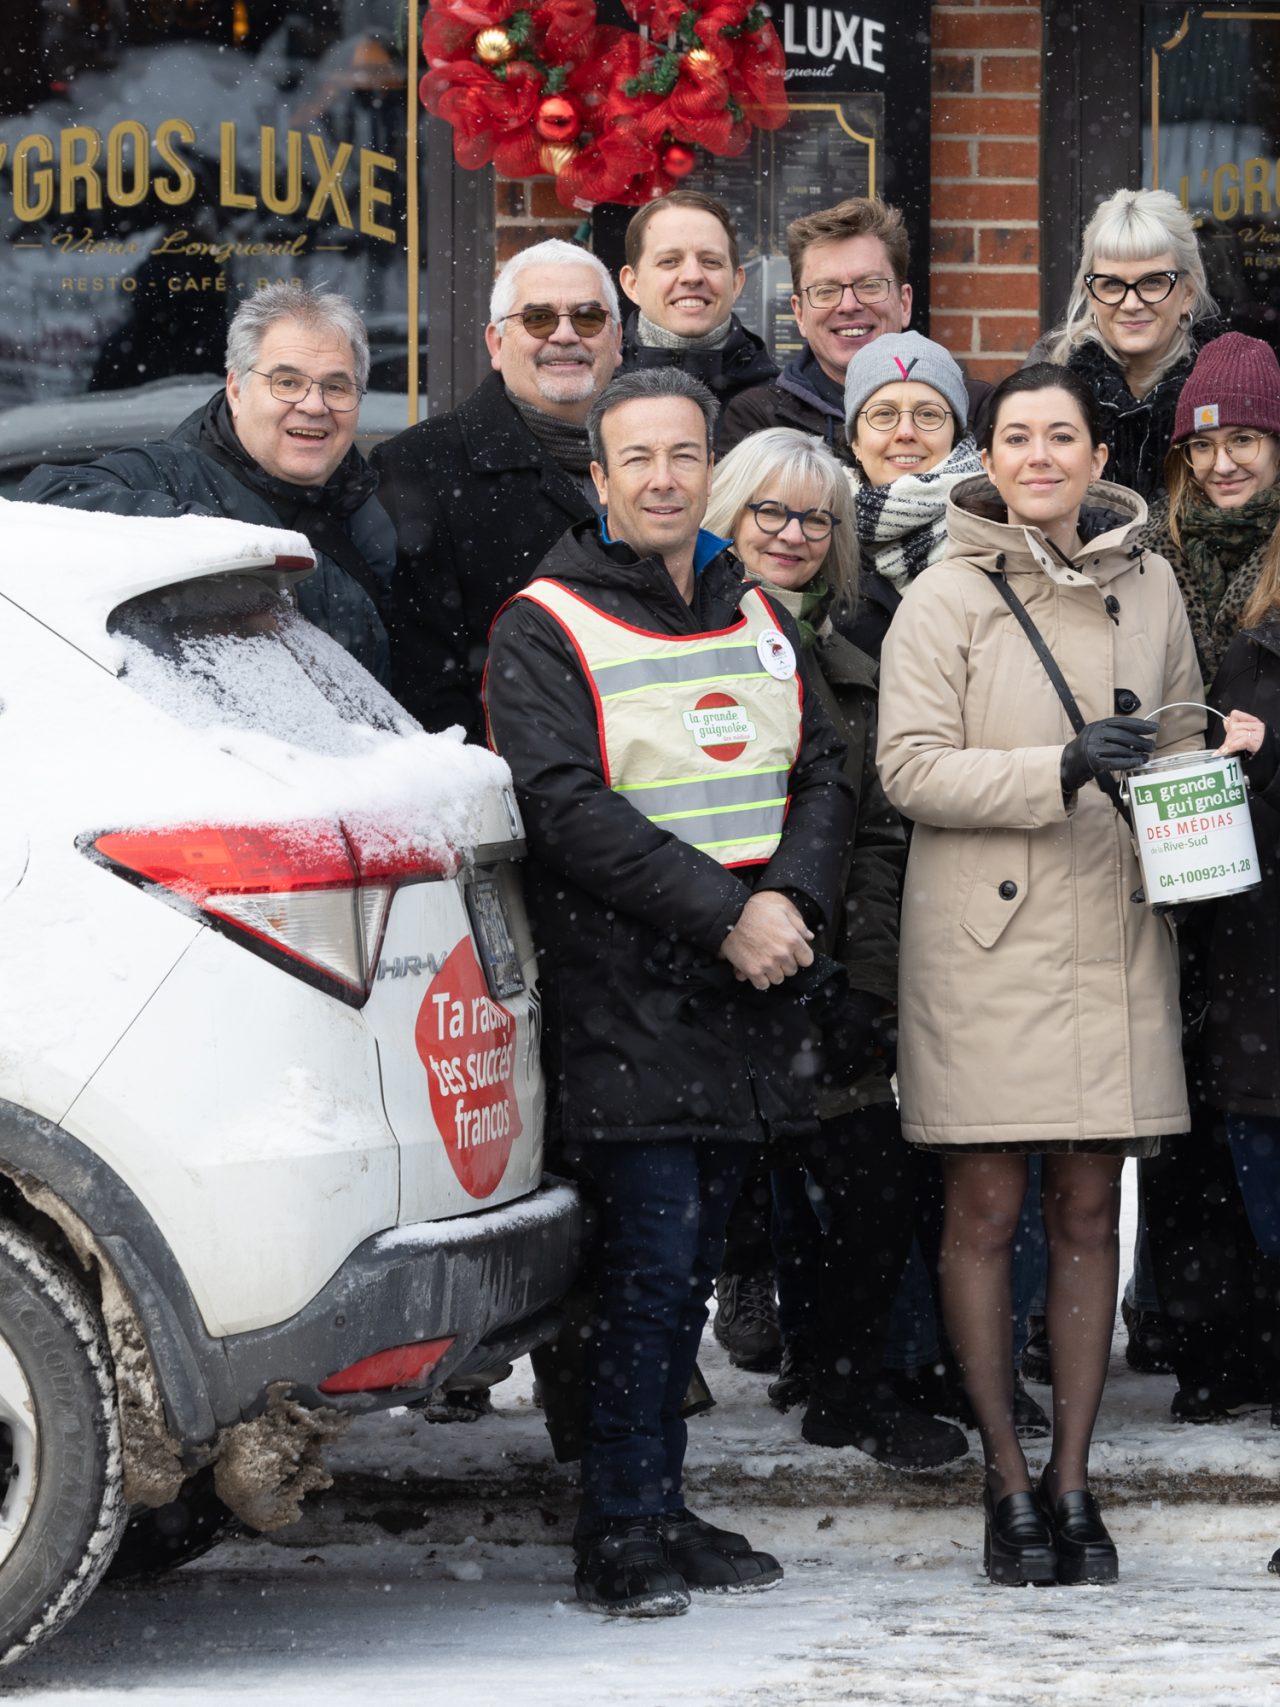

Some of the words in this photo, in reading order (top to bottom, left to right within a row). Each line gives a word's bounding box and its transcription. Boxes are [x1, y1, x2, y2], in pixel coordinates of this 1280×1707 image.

[784, 3, 885, 73] LUXE
[0, 118, 197, 222] 'GROS
[219, 121, 397, 244] LUXE
[51, 228, 137, 256] Vieux
[150, 229, 306, 264] Longueuil
[62, 277, 137, 291] RESTO
[168, 271, 227, 291] CAFÉ
[688, 712, 699, 724] la
[703, 710, 738, 726] grande
[699, 721, 747, 739] guignolée
[1226, 762, 1240, 782] 11
[1137, 788, 1153, 804] La
[1160, 776, 1217, 801] grande
[1166, 782, 1242, 818] guignolée
[1147, 825, 1171, 840] DES
[1177, 812, 1234, 836] MÉDIAS
[1163, 835, 1209, 853] Rive-Sud
[1159, 858, 1251, 888] CA-100923-1.28
[377, 951, 447, 981] HR-V
[432, 992, 465, 1040] Ta
[428, 1055, 467, 1097] tes
[466, 1032, 513, 1091] succès
[454, 1099, 510, 1150] francos
